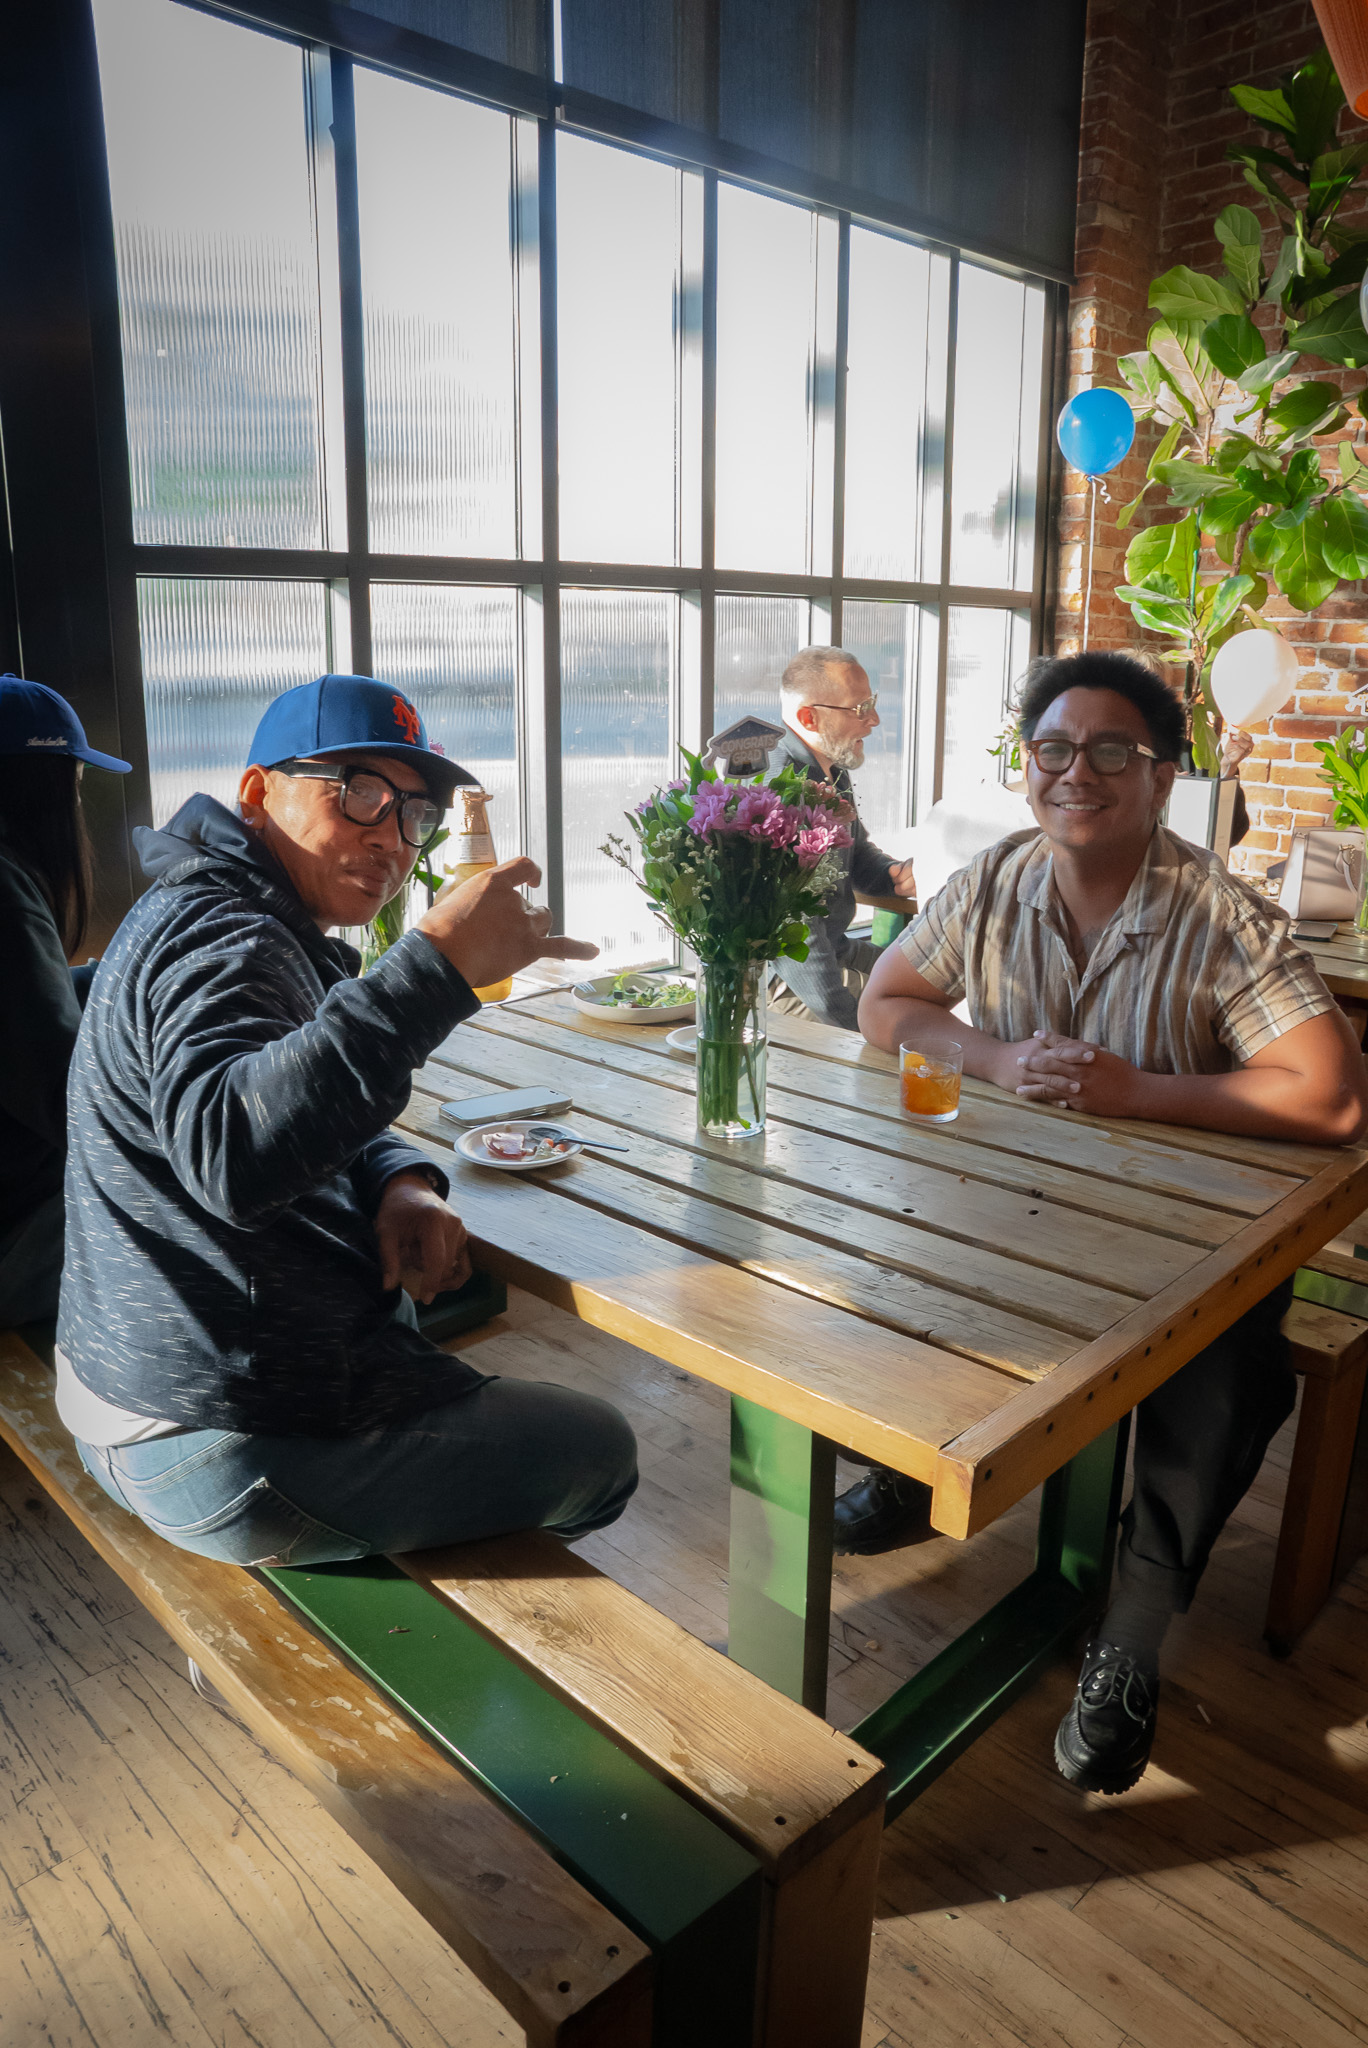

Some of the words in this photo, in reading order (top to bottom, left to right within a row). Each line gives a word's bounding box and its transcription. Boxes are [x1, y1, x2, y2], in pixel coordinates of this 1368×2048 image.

[392, 695, 420, 744] NY
[720, 734, 776, 754] CONGRATS
[732, 749, 761, 764] GRAD
